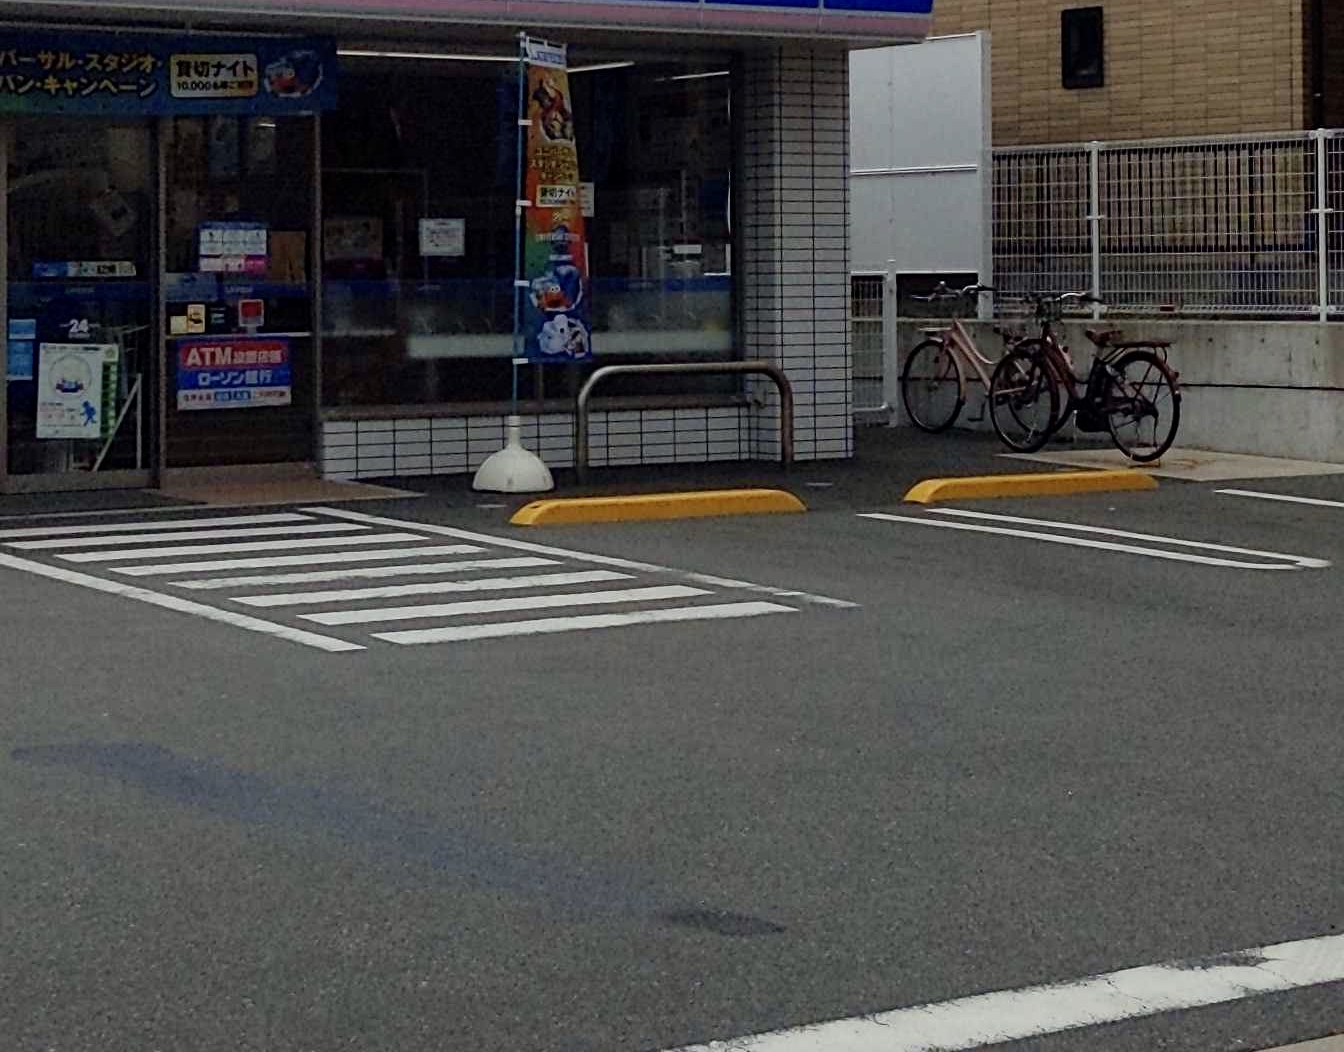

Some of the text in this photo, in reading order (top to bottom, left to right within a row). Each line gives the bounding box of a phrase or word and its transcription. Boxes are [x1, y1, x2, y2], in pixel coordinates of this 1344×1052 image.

[176, 59, 254, 78] 貸切ナイト
